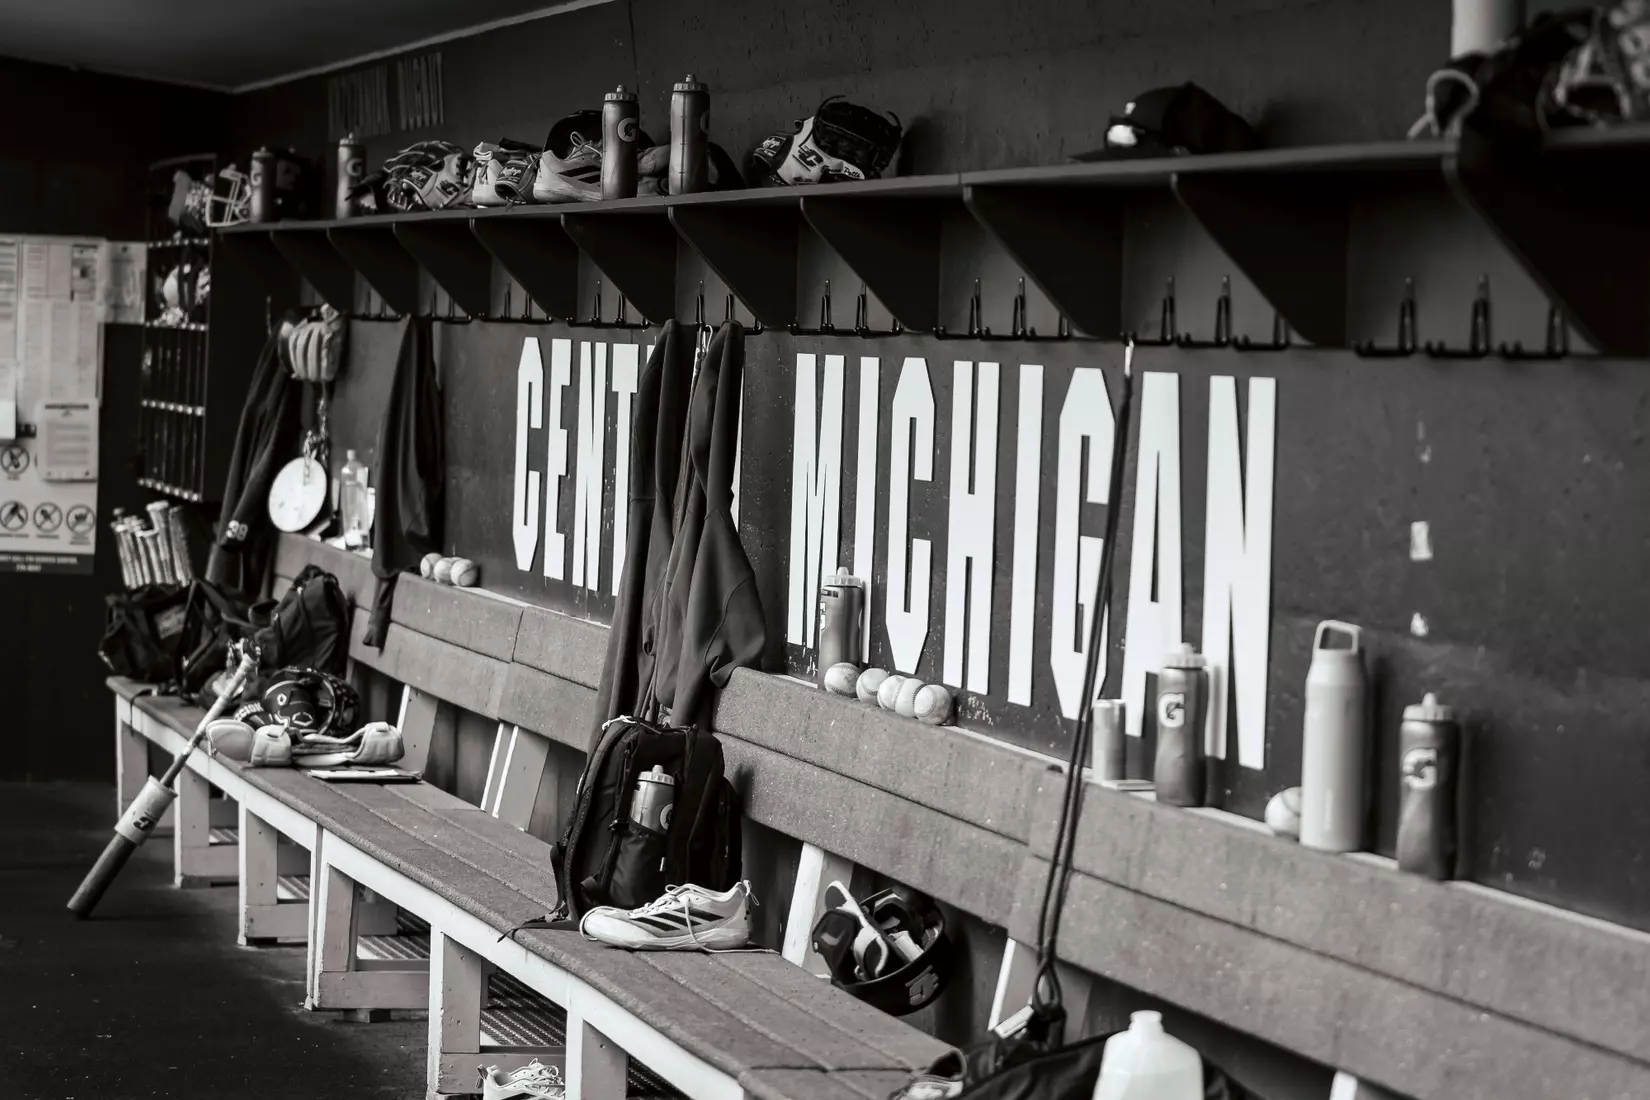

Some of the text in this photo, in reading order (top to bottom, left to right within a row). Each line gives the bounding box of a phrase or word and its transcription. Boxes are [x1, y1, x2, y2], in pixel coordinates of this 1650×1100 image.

[617, 117, 637, 142] G
[226, 520, 248, 541] 38
[512, 336, 1277, 771] CENT MICHIGAN
[1158, 692, 1185, 728] G
[1402, 748, 1438, 790] G
